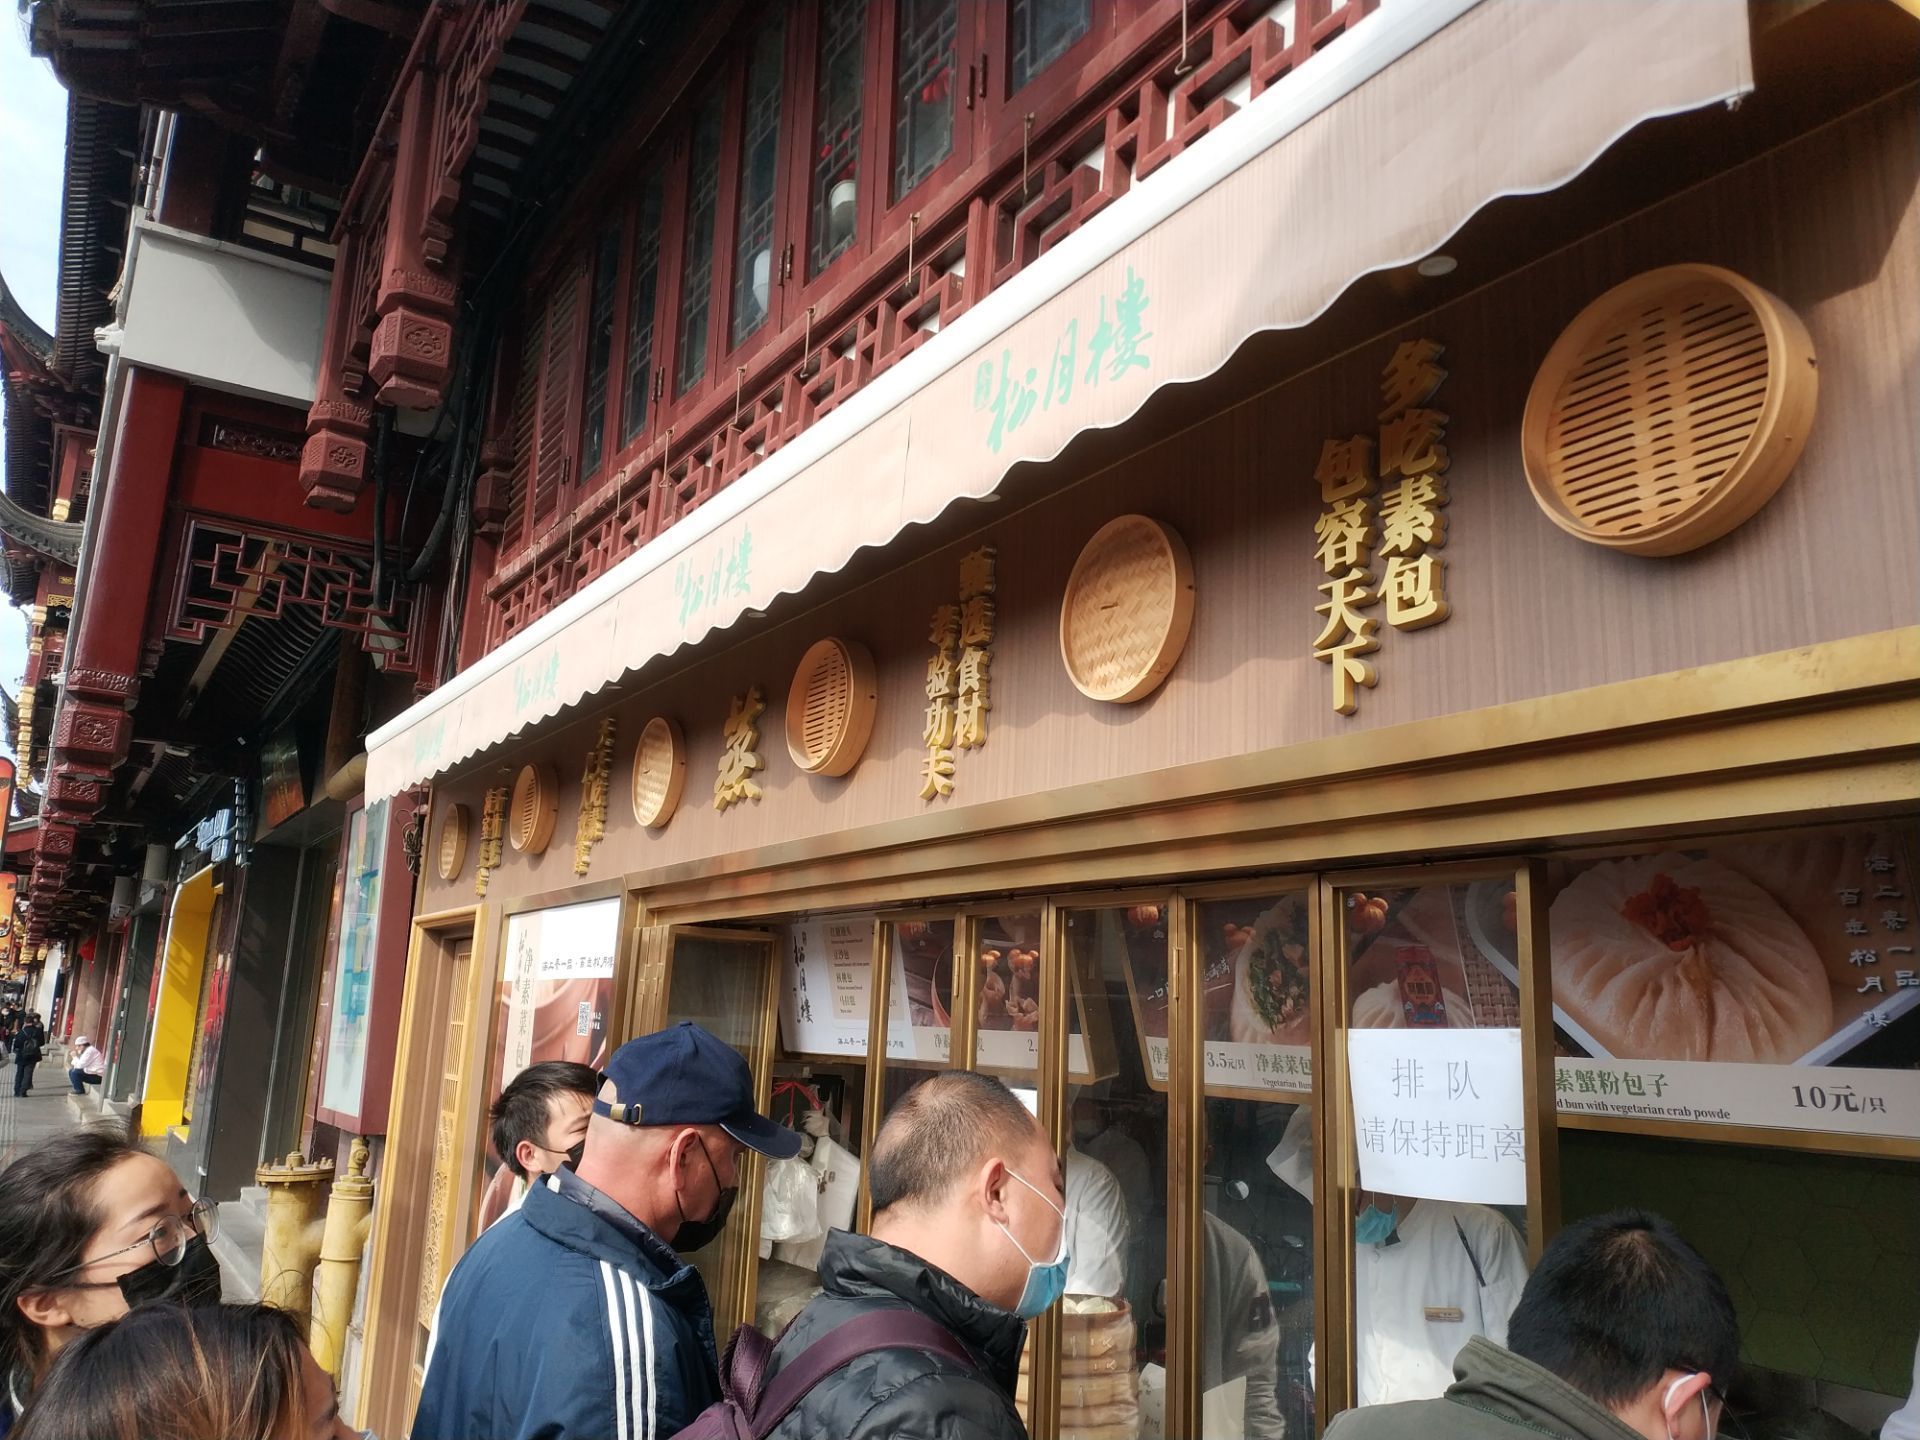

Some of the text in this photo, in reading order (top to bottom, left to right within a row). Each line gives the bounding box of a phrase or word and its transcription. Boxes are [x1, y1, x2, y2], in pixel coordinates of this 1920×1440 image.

[1378, 338, 1450, 630] 多吃素包
[1313, 434, 1381, 715] 包容天下
[1565, 1100, 1584, 1110] bun
[1586, 1101, 1609, 1112] with
[1610, 1104, 1665, 1116] vegetarian
[1667, 1106, 1691, 1117] crab
[1791, 1084, 1887, 1114] 10元/只
[1360, 1116, 1526, 1162] 请保持距离
